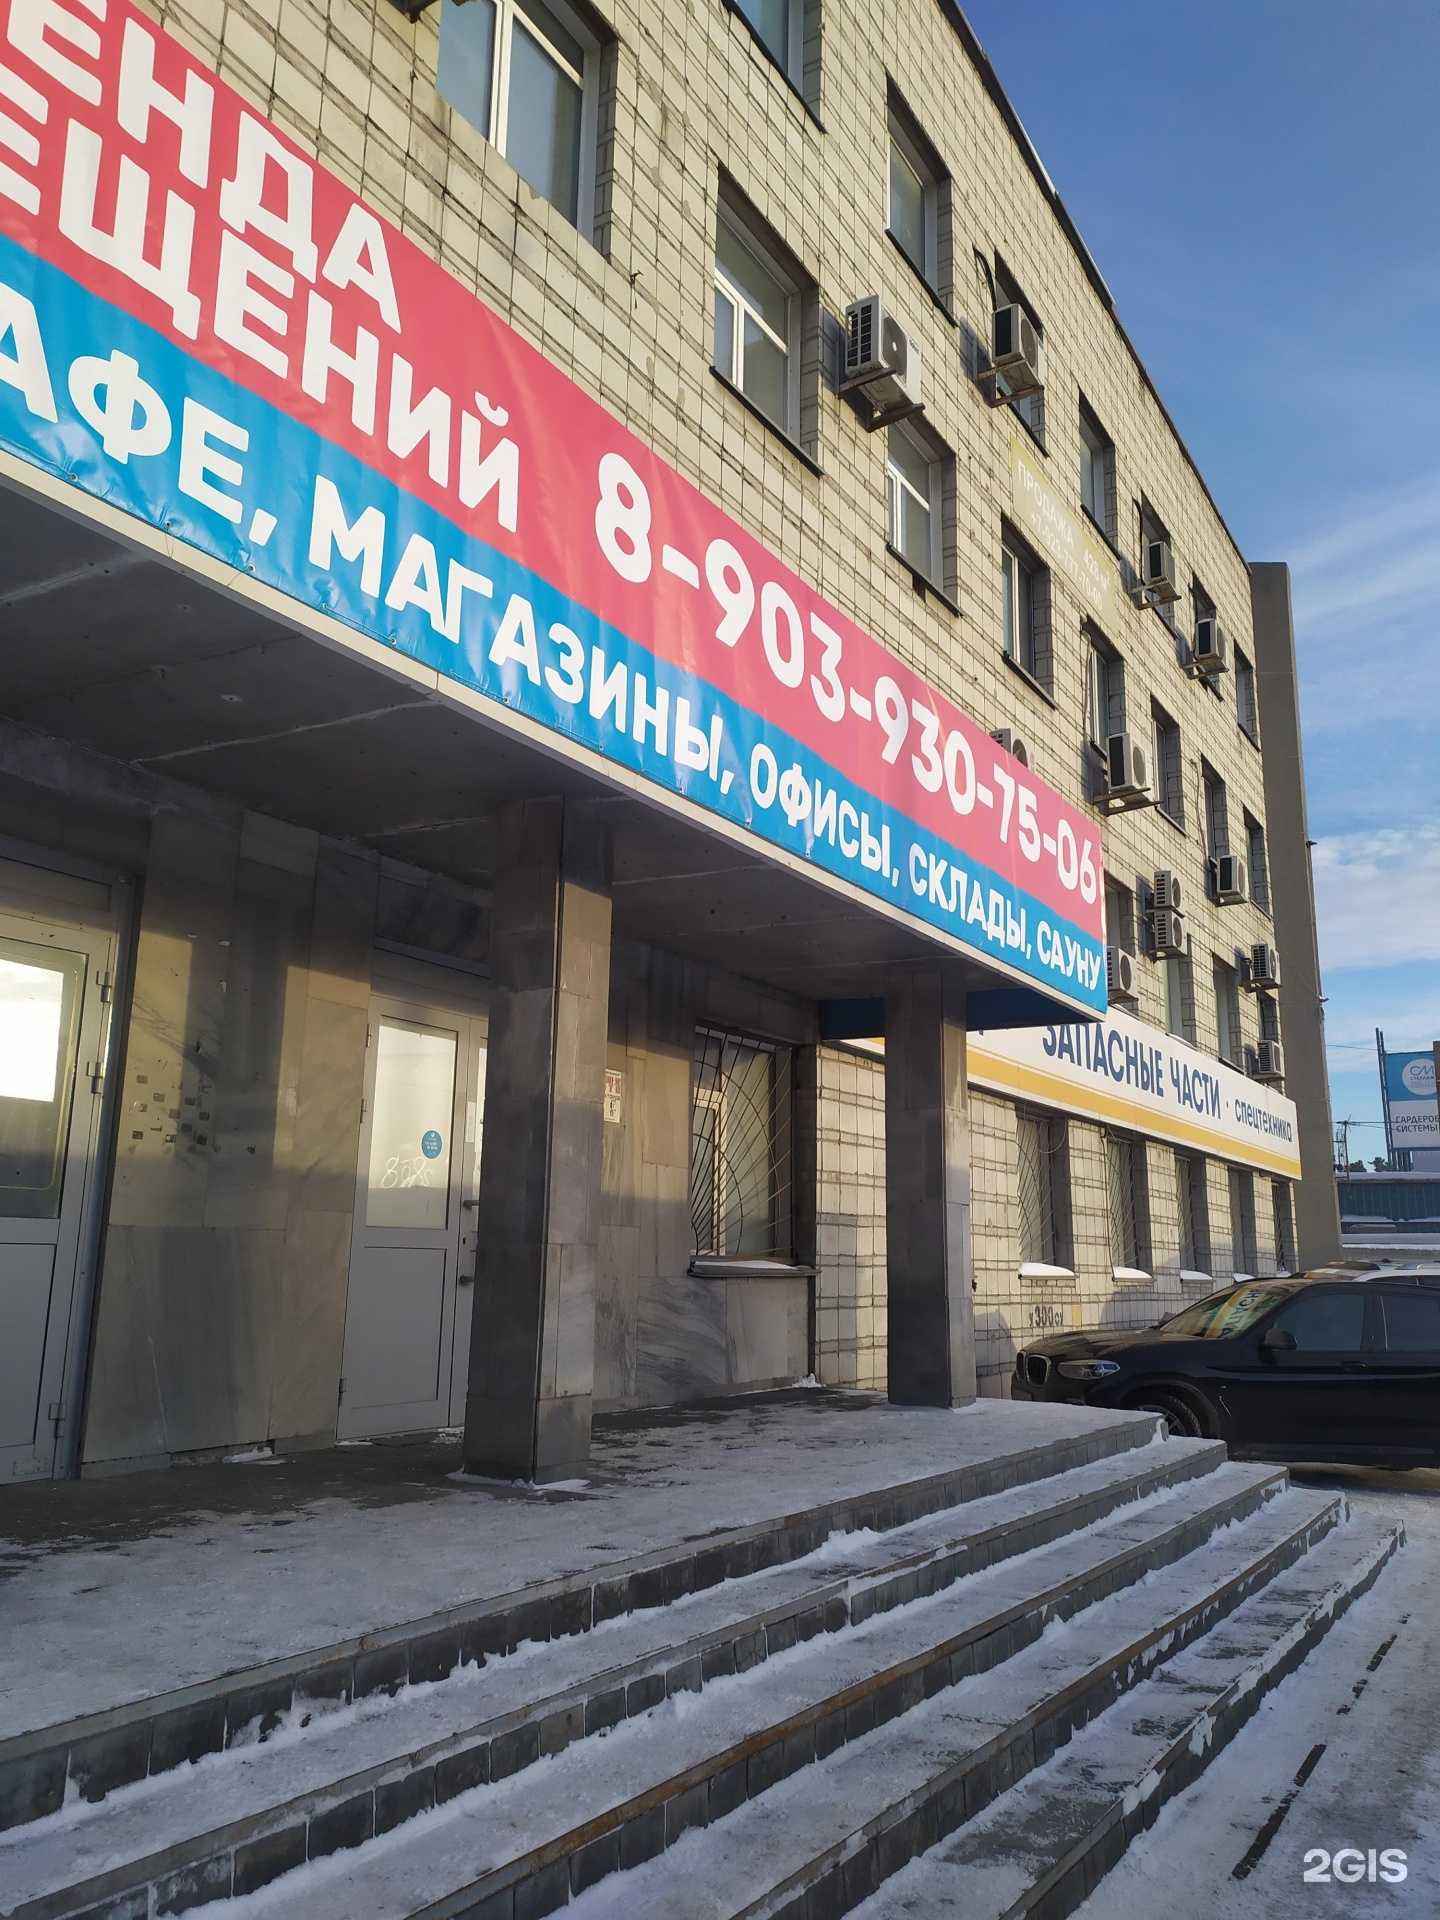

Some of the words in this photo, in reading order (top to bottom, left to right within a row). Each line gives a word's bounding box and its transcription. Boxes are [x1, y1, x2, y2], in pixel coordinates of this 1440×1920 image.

[309, 474, 735, 795] МАГАЗИНЫ,
[749, 742, 901, 887] ОФИСЫ,
[908, 842, 1032, 958] СКЛАДЫ,
[1037, 921, 1101, 992] САУНУ
[594, 451, 1098, 905] 8-903-930-75-06
[1170, 1057, 1221, 1119] ЧАСТИ
[1235, 1098, 1293, 1142] спецтехника
